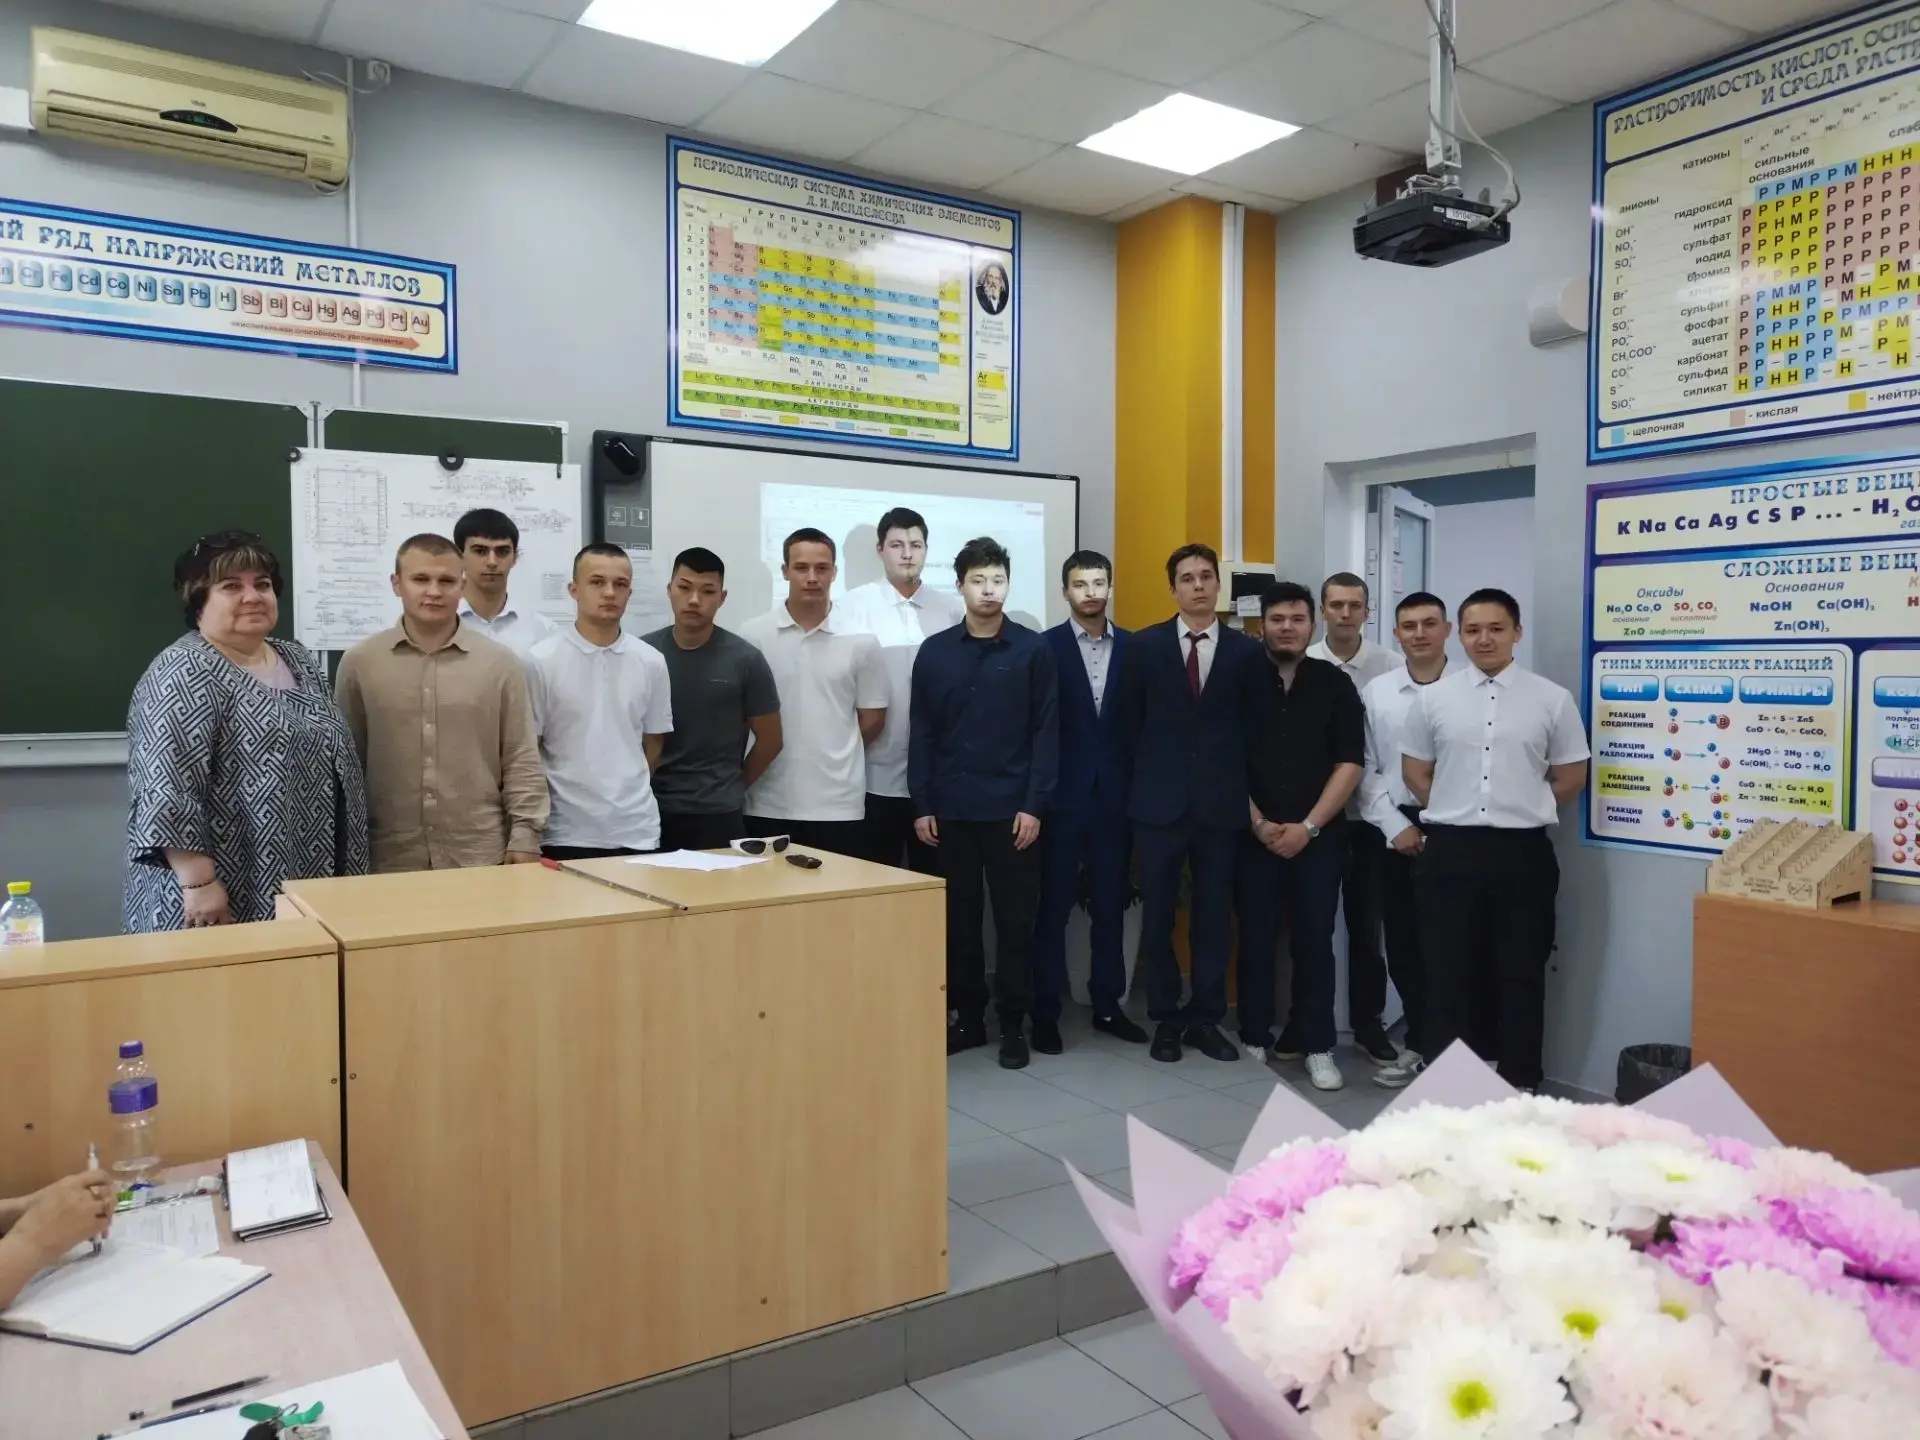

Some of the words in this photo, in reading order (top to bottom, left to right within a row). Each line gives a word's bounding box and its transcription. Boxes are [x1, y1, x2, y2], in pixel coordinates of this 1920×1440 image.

[1761, 86, 1774, 105] И
[1780, 63, 1850, 98] СРЕДА
[1613, 68, 1766, 134] РАСТВОРИМОСТЬ
[1682, 150, 1730, 170] катионы
[1754, 146, 1810, 169] сильные
[1749, 158, 1815, 184] основания
[693, 156, 799, 189] ПЕРИОДИЧЕСКАЯ
[804, 179, 855, 201] СИСТЕМА
[860, 192, 934, 217] ХИМИЧЕСКИХ
[939, 208, 1001, 232] ЭЛЕМЕНТОВ
[832, 201, 905, 225] МЕНДЕЛЕЕВА
[1620, 197, 1659, 213] анионы
[1674, 197, 1733, 220] гидроксид
[1694, 214, 1732, 231] нитрат
[1683, 231, 1731, 251] сульфат
[39, 226, 94, 252] РЯД
[106, 234, 284, 277] НАПРЯЖЕНИЙ
[296, 262, 421, 297] МЕТАЛЛОВ
[1695, 249, 1731, 265] иодид
[52, 270, 67, 283] Fe
[79, 273, 99, 287] Cd
[107, 276, 127, 290] Co
[138, 280, 152, 293] Ni
[163, 284, 181, 297] Sn
[190, 288, 208, 301] Pb
[242, 294, 260, 306] Sb
[270, 297, 283, 309] Bi
[293, 301, 310, 313] Cu
[318, 303, 335, 318] Hg
[342, 306, 359, 321] Ag
[367, 308, 382, 321] Pd
[392, 312, 404, 324] Pt
[412, 315, 428, 328] Au
[1680, 300, 1729, 317] сульфит
[1684, 316, 1729, 333] фосфат
[1692, 332, 1728, 346] ацетат
[1677, 350, 1728, 366] карбонат
[1678, 366, 1728, 383] сульфид
[1683, 382, 1727, 397] силикат
[1756, 406, 1798, 418] кислая
[1632, 421, 1684, 437] щелочная
[1730, 478, 1848, 504] ПРОСТЫЕ
[1857, 471, 1920, 493] ВЕЩ
[1618, 521, 1631, 535] K
[1639, 519, 1666, 533] Na
[1675, 516, 1699, 530] Ca
[1708, 513, 1738, 530] Ag
[1769, 508, 1781, 523] S
[1724, 556, 1851, 578] СЛОЖНЫЕ
[1637, 586, 1684, 598] Оксиды
[1765, 581, 1844, 594] Основания
[1750, 601, 1792, 612] NaOH
[1624, 627, 1645, 636] ZnO
[1600, 659, 1641, 669] ТИПЫ
[1645, 659, 1750, 670] ХИМИЧЕСКИХ
[1754, 656, 1833, 672] РЕАКЦИЙ
[1609, 711, 1646, 719] РЕАКЦИЯ
[1601, 720, 1654, 729] СОЕДИНЕНИЯ
[1609, 742, 1645, 750] РЕАКЦИЯ
[1600, 750, 1654, 759] РАЗЛОЖЕНИЯ
[1608, 773, 1644, 782] РЕАКЦИЯ
[1601, 782, 1651, 791] ЗАМЕЩЕНИЯ
[1607, 806, 1642, 815] РЕАКЦИЯ
[1608, 815, 1641, 824] ОБМЕНА
